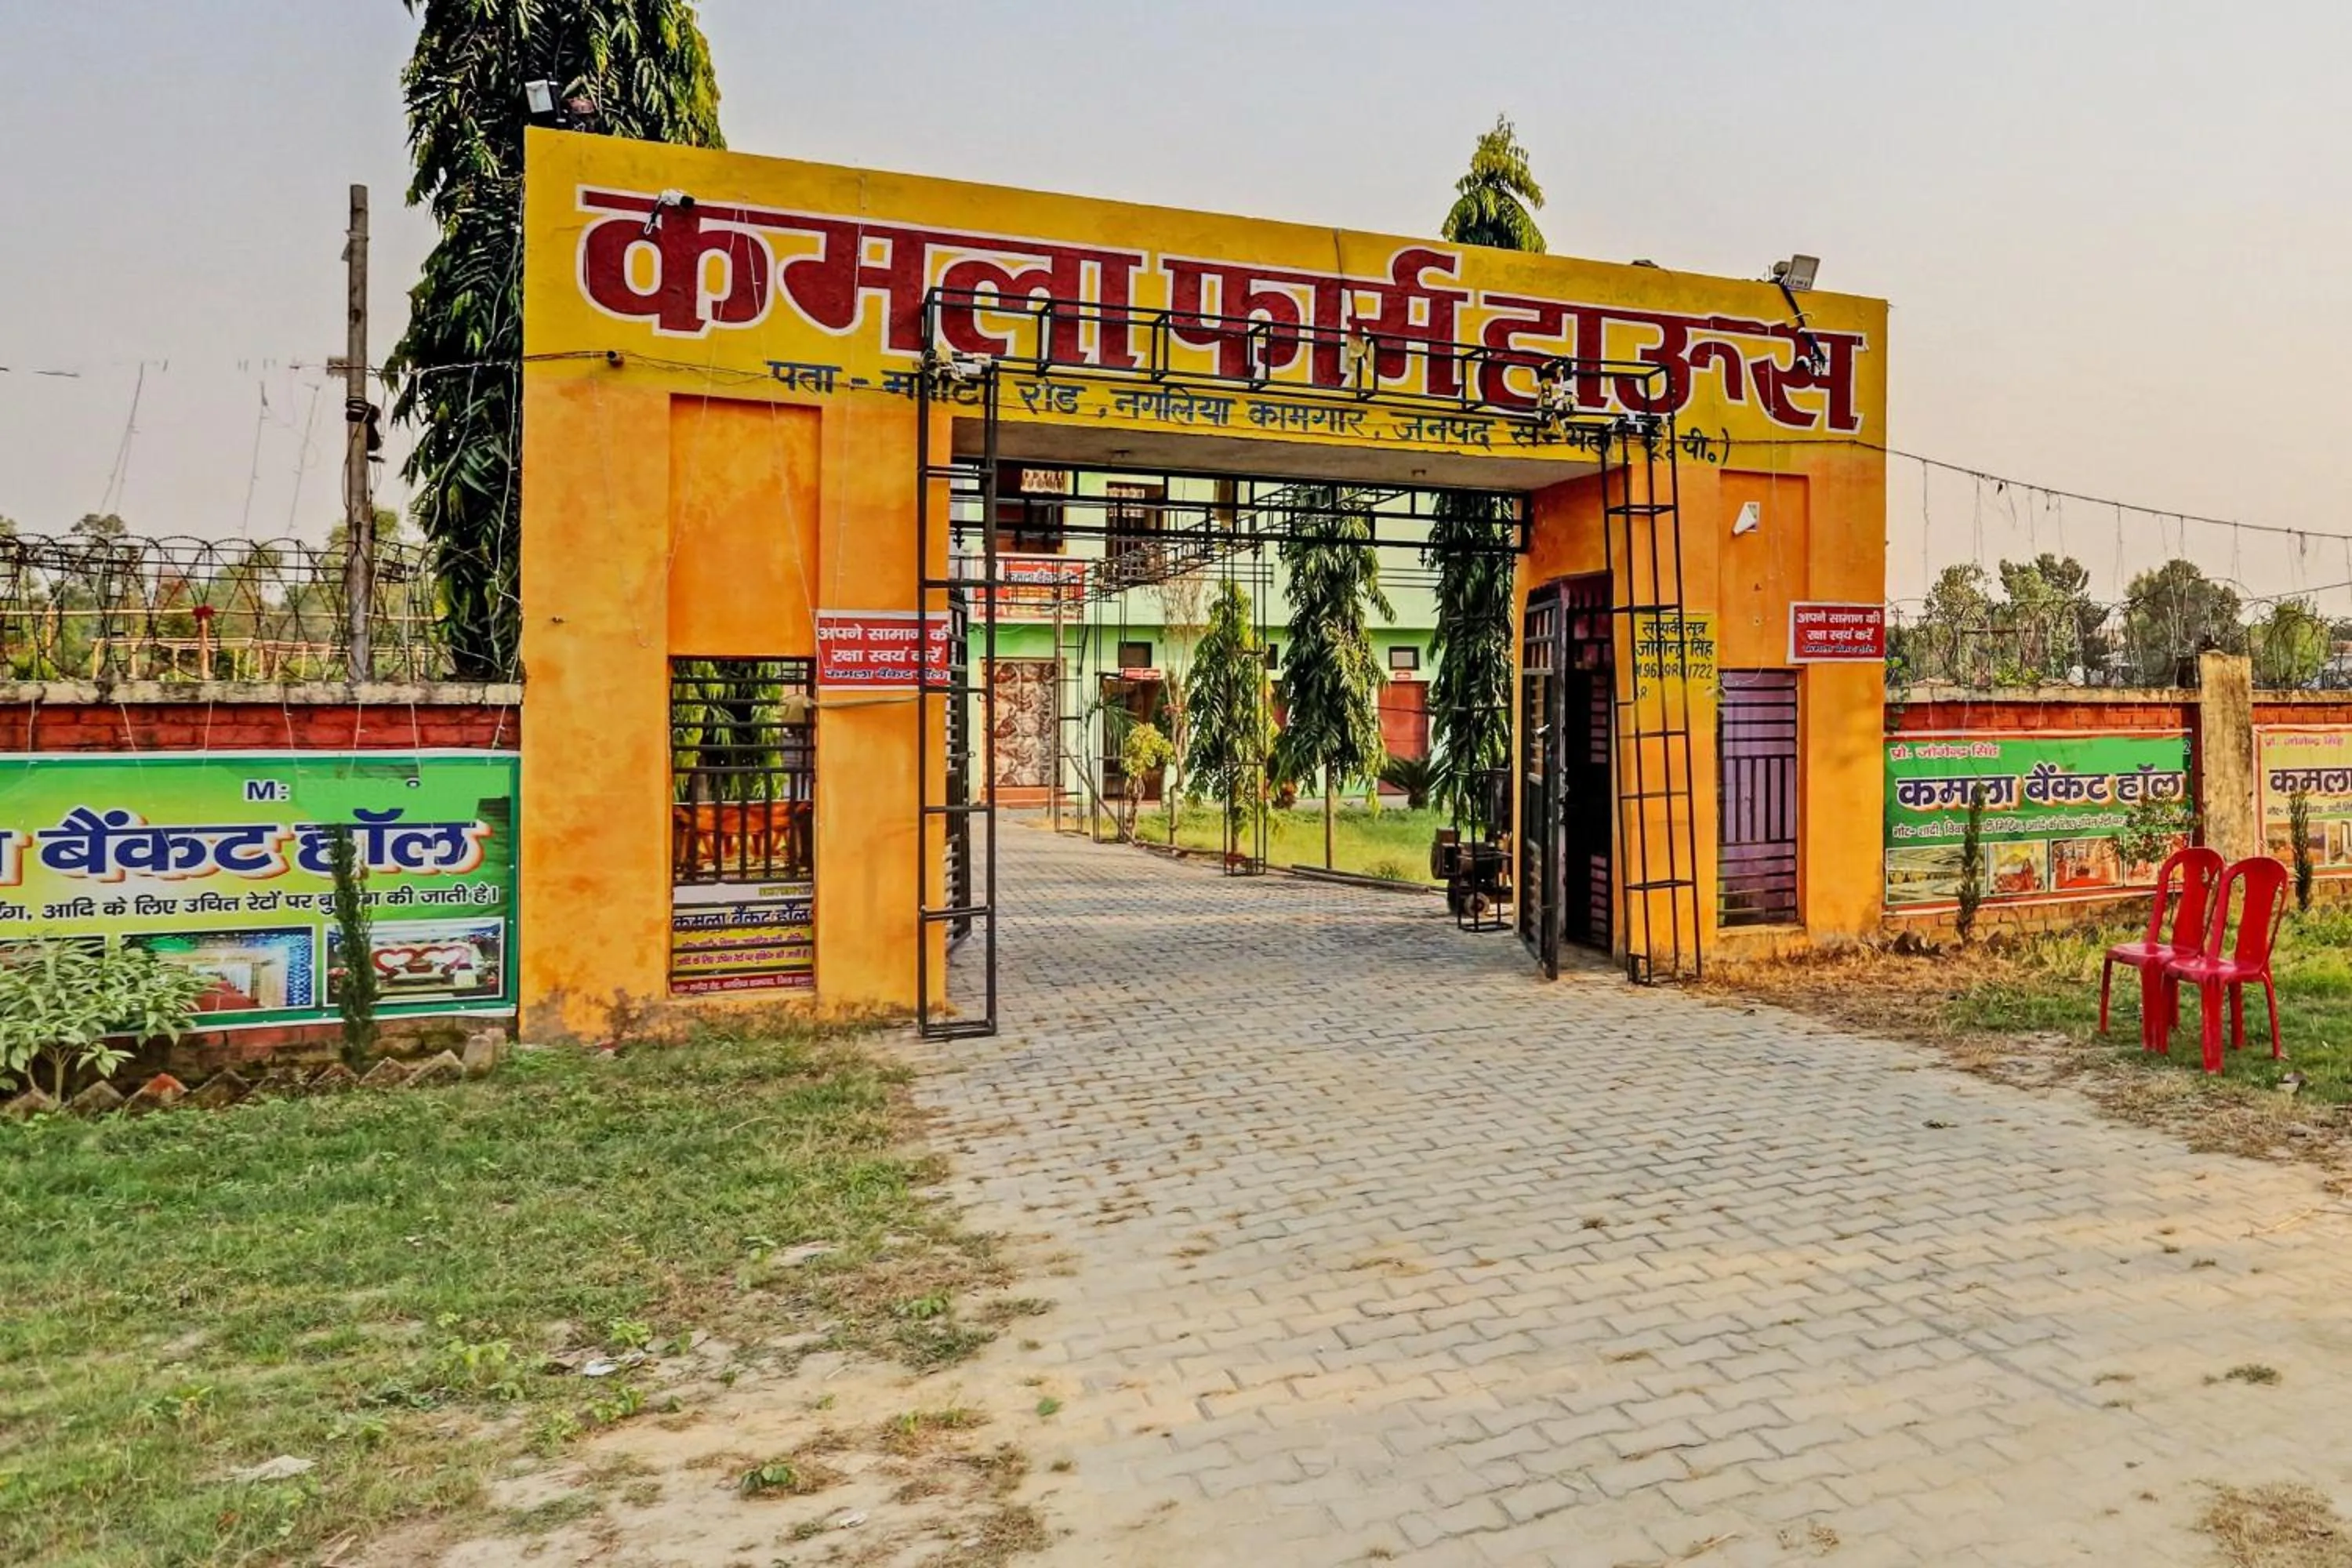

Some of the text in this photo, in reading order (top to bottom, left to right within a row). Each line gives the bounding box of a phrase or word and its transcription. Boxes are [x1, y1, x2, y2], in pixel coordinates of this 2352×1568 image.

[576, 185, 1149, 376] कमला
[1158, 245, 1468, 400] फार्म
[764, 360, 842, 395] पता
[1109, 384, 1237, 426] नगलिया
[1390, 411, 1495, 452] जनपद
[818, 623, 863, 641] अपने
[1797, 610, 1881, 624] अपने सामान की
[831, 648, 864, 663] रक्षा
[867, 647, 908, 663] स्वयं
[1690, 637, 1715, 661] सिंह
[1896, 763, 2184, 807] कमला बैंकट हॉल
[38, 806, 279, 877] बैंकट
[295, 808, 480, 873] हॉल
[42, 897, 96, 920] आदि
[103, 896, 127, 916] के
[134, 895, 178, 916] लिए
[184, 891, 240, 913] उचित
[246, 891, 283, 911] रेटों
[286, 893, 314, 909] पर
[386, 886, 414, 906] की
[420, 884, 468, 906] जाती
